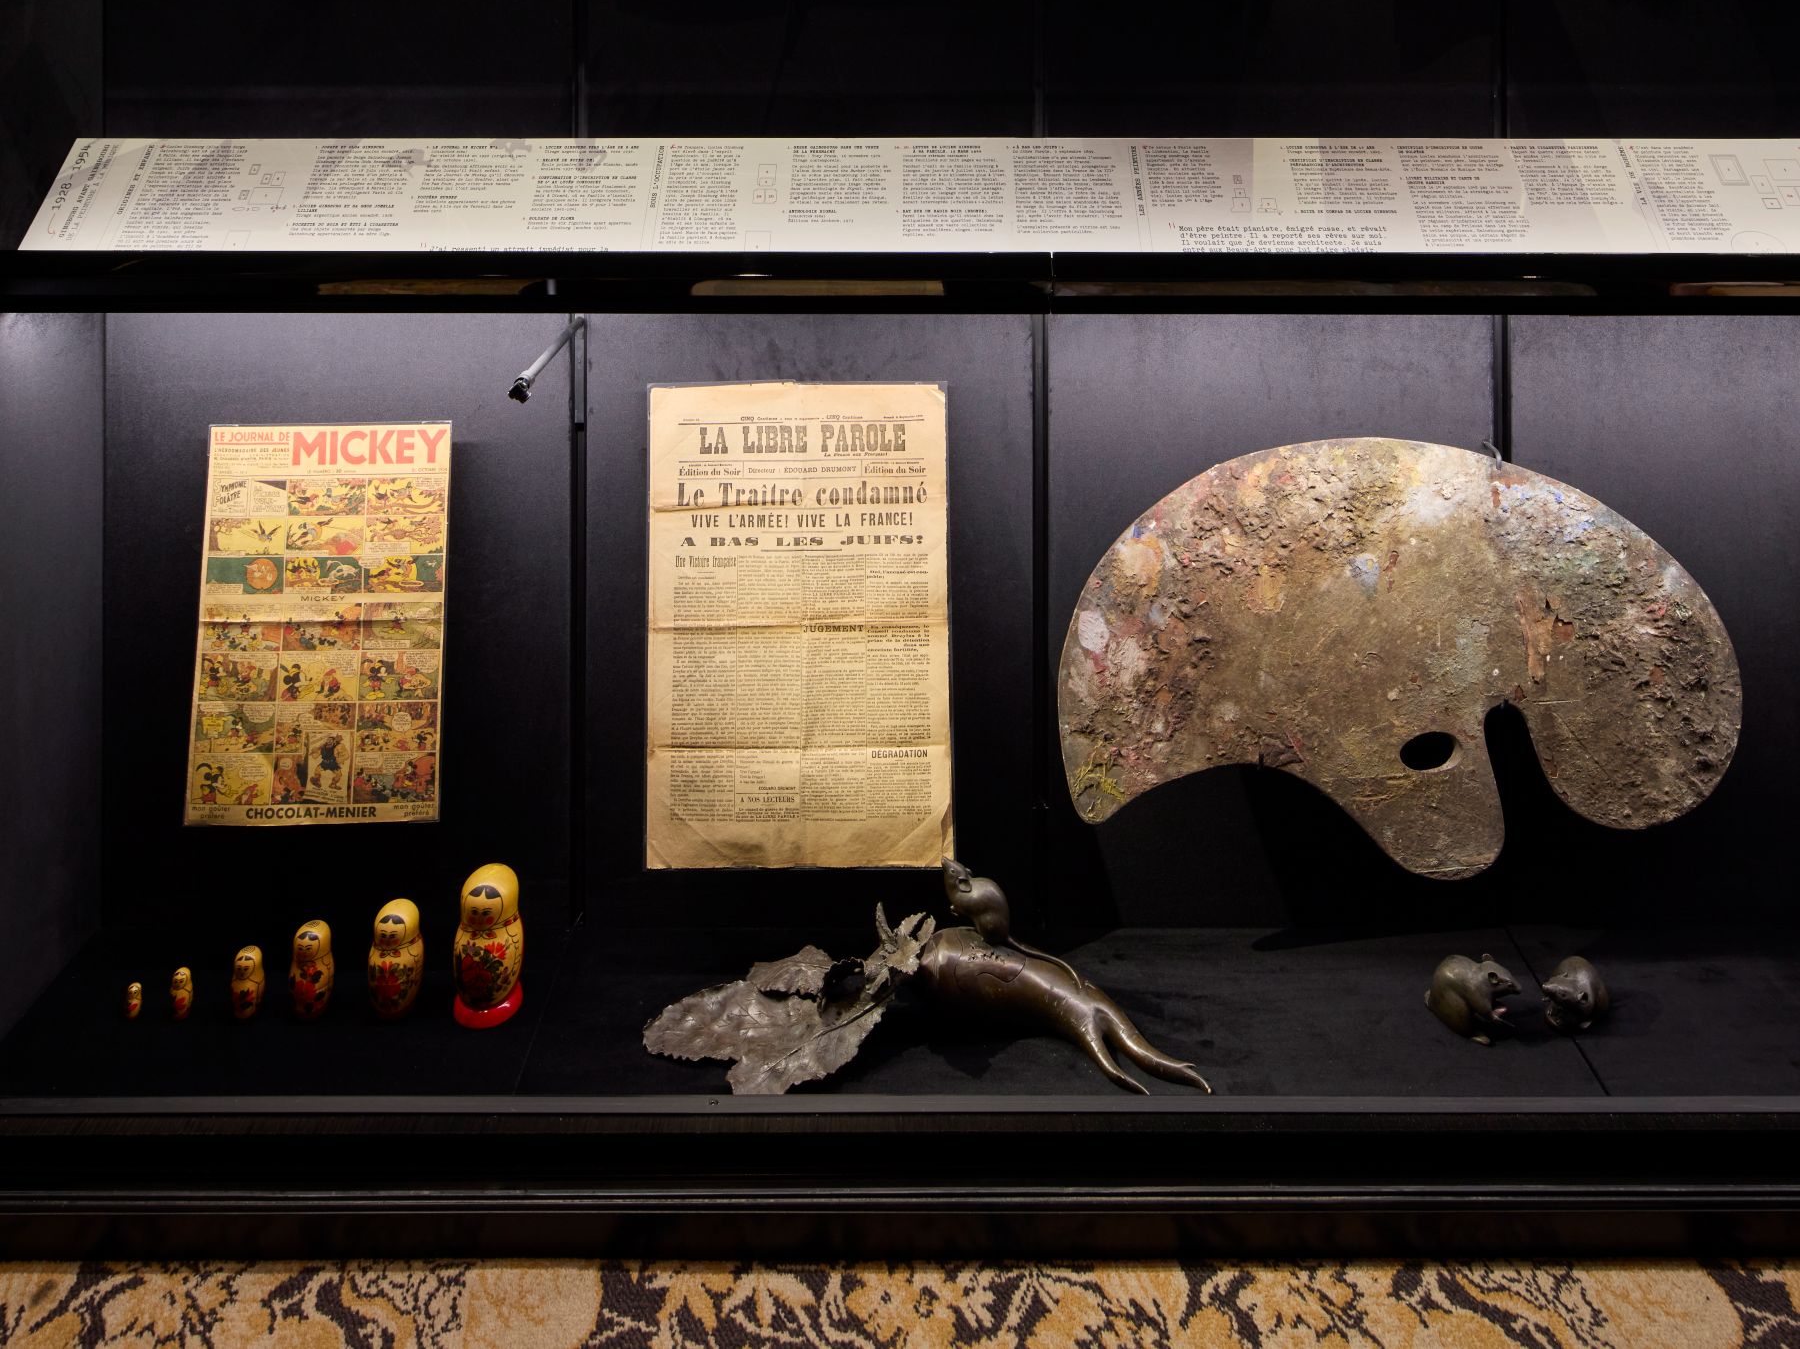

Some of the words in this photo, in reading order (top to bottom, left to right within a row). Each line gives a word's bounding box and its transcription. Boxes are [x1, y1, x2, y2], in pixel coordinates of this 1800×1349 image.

[652, 146, 664, 190] L'OCCUPATION
[51, 182, 72, 211] 1928
[71, 145, 91, 172] 1954
[215, 432, 225, 441] LE
[229, 432, 274, 442] JOURNAL
[279, 432, 290, 441] DE
[699, 426, 728, 454] LA
[742, 425, 808, 454] LIBRE
[820, 423, 906, 452] PAROLE
[292, 430, 446, 465] MICKEY
[678, 466, 708, 477] Édition
[710, 468, 721, 477] du
[724, 468, 742, 476] Soir
[748, 466, 776, 475] Directeur
[784, 466, 818, 474] ÉDOUARD
[820, 465, 856, 474] DRUMONT
[864, 464, 894, 474] Édition
[895, 465, 906, 474] du
[907, 464, 926, 474] Soir
[676, 482, 705, 507] Le
[718, 482, 804, 507] Traître
[816, 480, 928, 506] condamné
[691, 514, 720, 528] VIVE
[797, 514, 826, 528] VIVE
[835, 513, 852, 528] LA
[680, 536, 696, 547] A
[710, 537, 759, 546] BAS
[776, 536, 824, 546] LES
[675, 555, 686, 569] Une
[688, 555, 710, 568] Victoire
[803, 624, 864, 634] JUGEMENT
[871, 747, 928, 759] DÉGRADATION
[763, 795, 795, 803] LECTEURS
[246, 806, 377, 820] CHOCOLAT-MENIER
